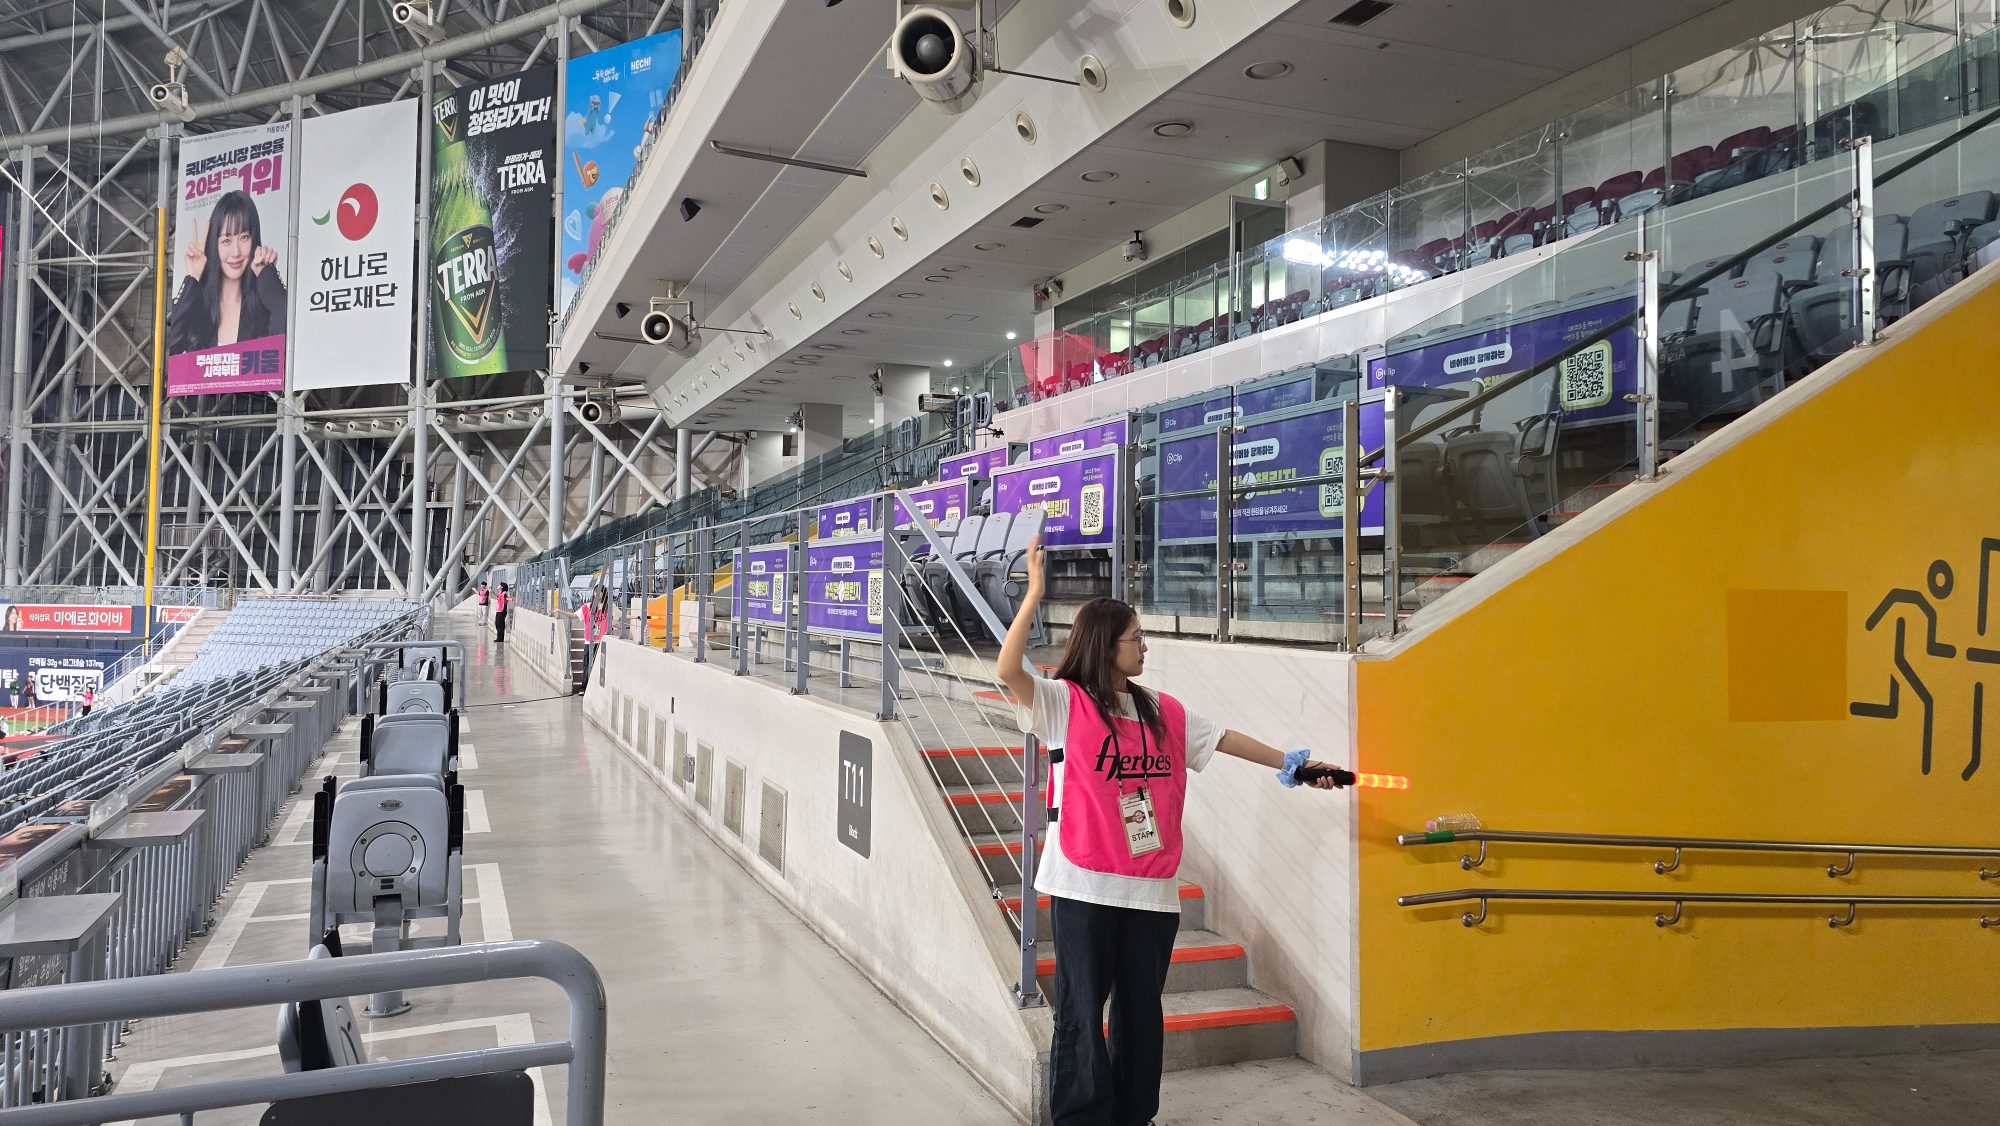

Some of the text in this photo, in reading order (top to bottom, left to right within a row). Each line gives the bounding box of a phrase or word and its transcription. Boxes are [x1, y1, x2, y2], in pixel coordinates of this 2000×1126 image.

[468, 78, 521, 112] 이 맛이
[467, 96, 552, 137] 청정라거다!
[185, 147, 249, 177] 국내주식시장
[250, 137, 285, 160] 점유율
[185, 154, 283, 200] 20년 연속 1위
[497, 159, 547, 192] TERRA
[321, 252, 388, 281] 하나로
[437, 245, 498, 302] TERRA
[309, 282, 398, 313] 의료재단
[460, 293, 475, 304] FROM
[241, 349, 280, 376] 키움
[1449, 349, 1506, 369] 네이버와 함께하는
[1173, 453, 1183, 463] Clip
[1250, 444, 1274, 458] 함께하는
[53, 610, 123, 626] 미에로화이바
[1093, 734, 1172, 782] Heroes
[843, 759, 864, 808] T11
[848, 823, 859, 840] Block
[1131, 829, 1154, 842] STAF
